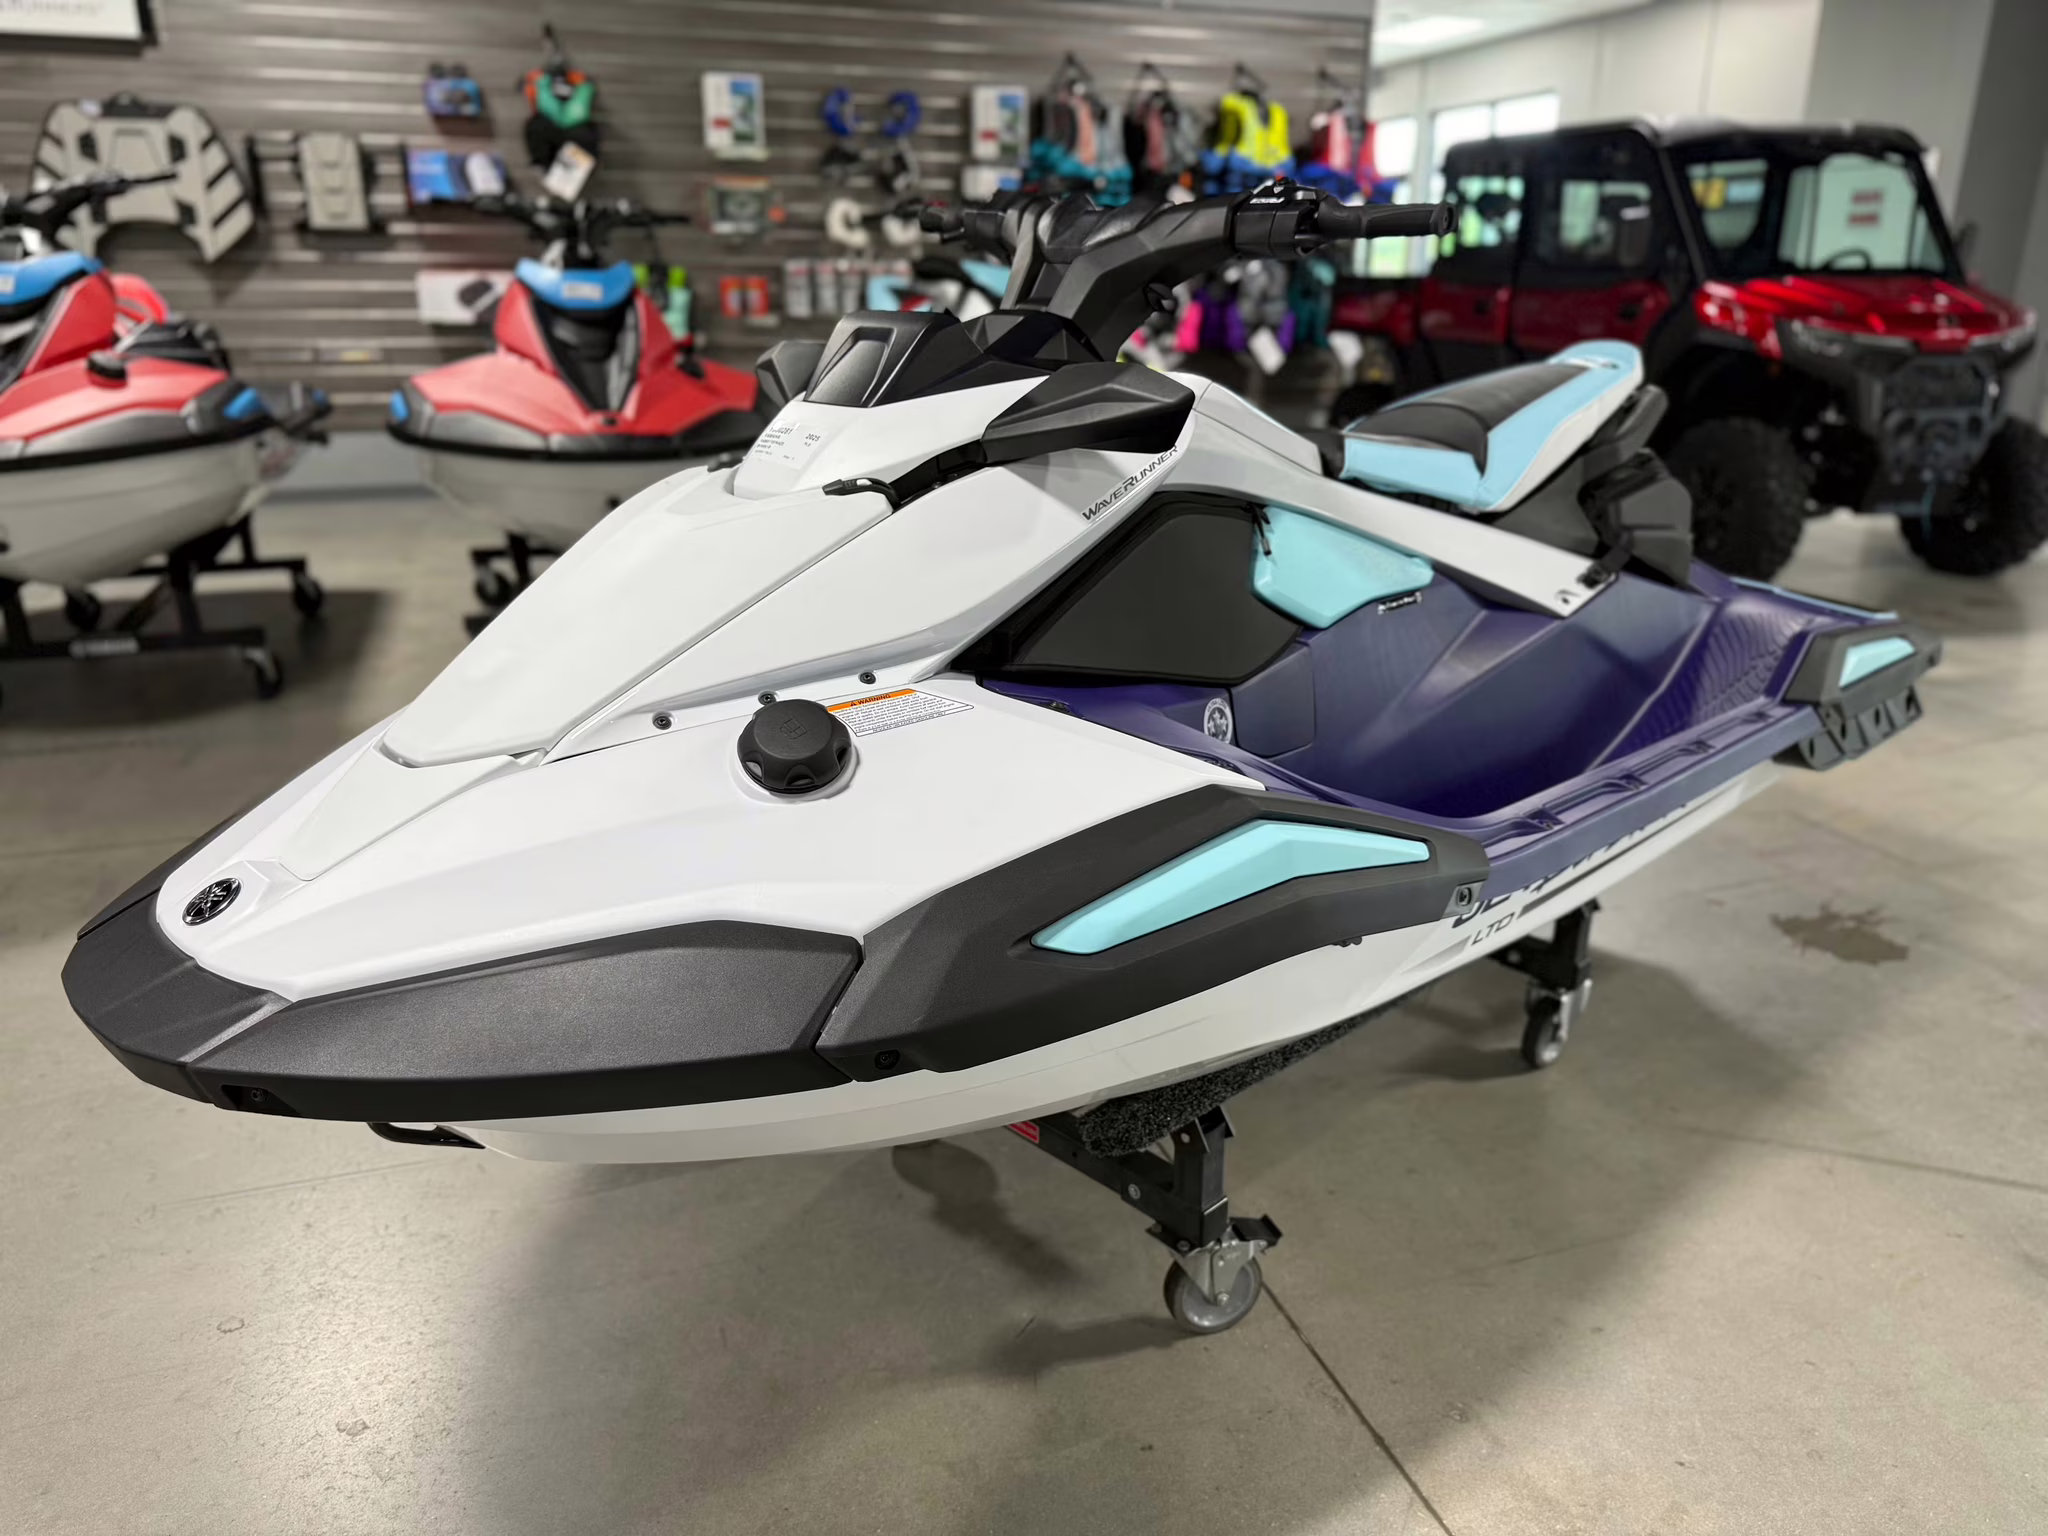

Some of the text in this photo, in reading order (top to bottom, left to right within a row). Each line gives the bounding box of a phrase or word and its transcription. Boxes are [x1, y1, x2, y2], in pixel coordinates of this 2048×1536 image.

[805, 433, 821, 441] 2025
[857, 694, 891, 704] WARNING
[1471, 911, 1515, 946] LTD
